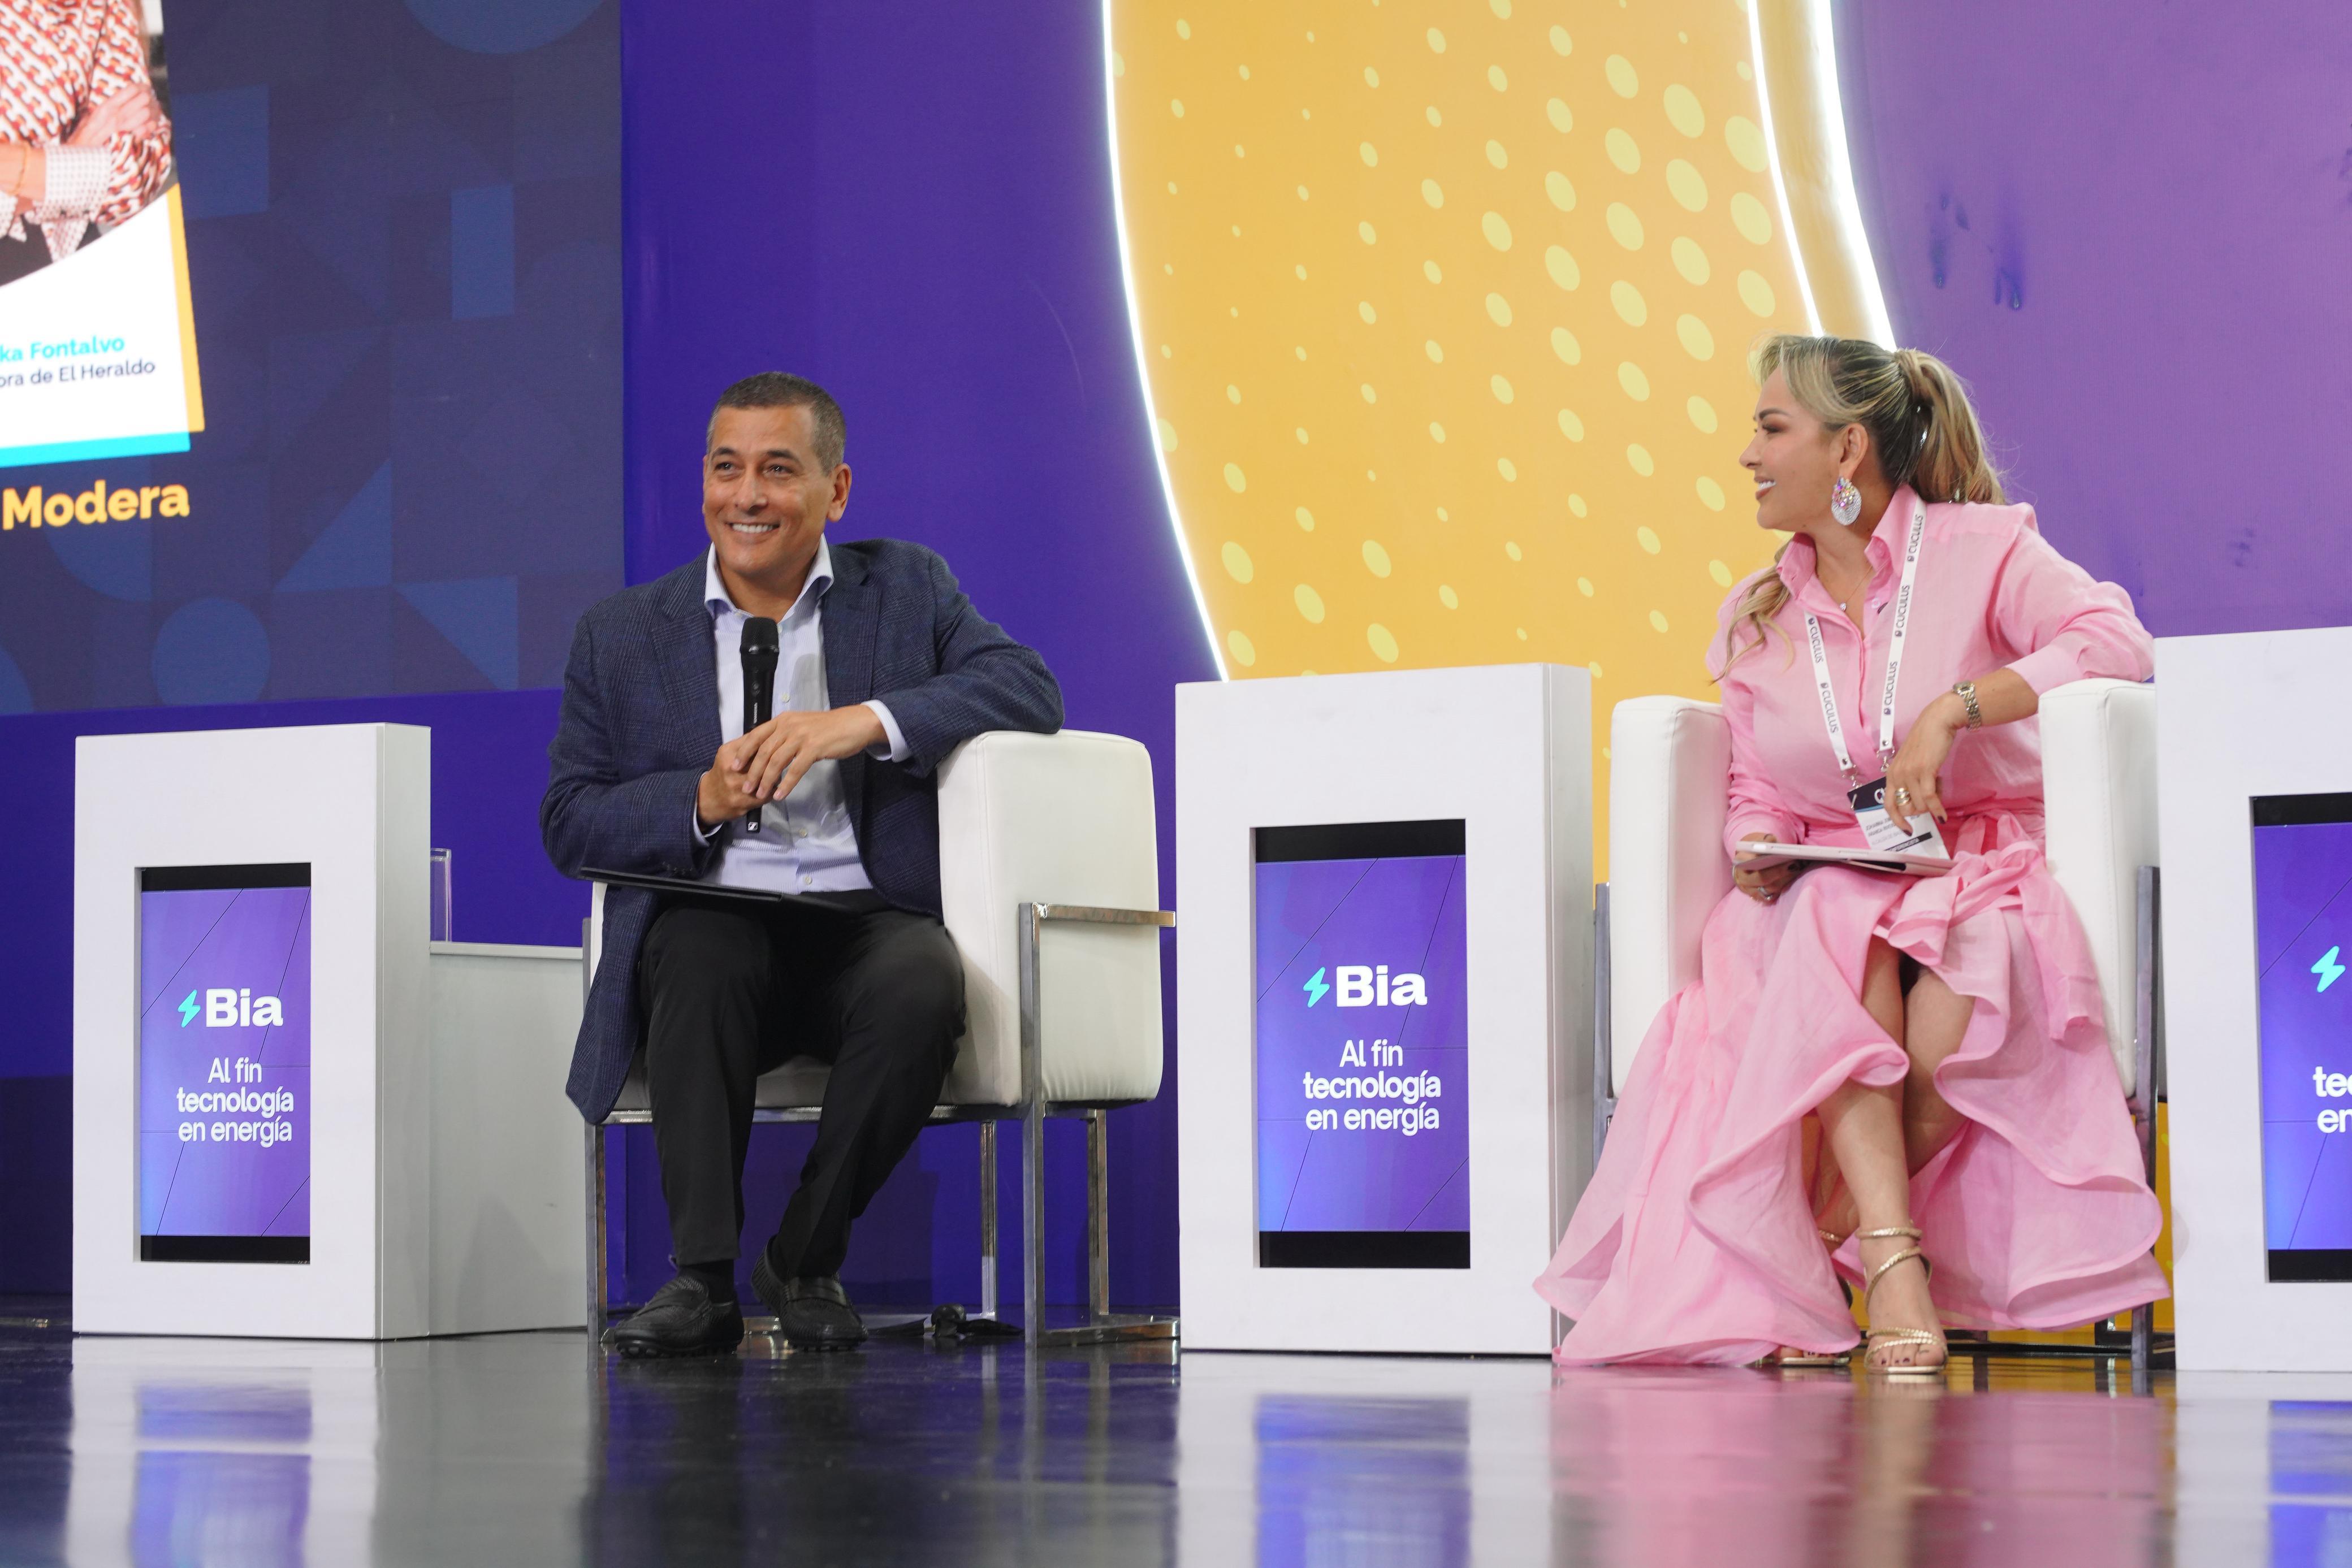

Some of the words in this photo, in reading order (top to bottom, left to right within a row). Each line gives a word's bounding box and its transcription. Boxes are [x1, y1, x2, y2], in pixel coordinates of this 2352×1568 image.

[30, 335, 125, 359] Fontalvo
[31, 367, 53, 384] de
[59, 365, 76, 382] El
[81, 358, 155, 379] Heraldo
[2, 479, 190, 530] Modera
[1908, 515, 1923, 554] CUCULUS
[1896, 584, 1910, 629] CUCULUS
[1810, 626, 1823, 663] CUCULUS
[1884, 661, 1897, 705] CUCULUS
[1822, 690, 1839, 733] CUCULUS
[1336, 964, 1428, 1007] Bia
[206, 988, 284, 1027] Bia
[207, 1057, 231, 1084] Al
[235, 1056, 262, 1083] fin
[1339, 1039, 1367, 1068] Al
[1370, 1038, 1403, 1067] fin
[1303, 1069, 1441, 1104] tecnología
[2312, 1066, 2352, 1097] te
[176, 1085, 294, 1119] tecnología
[1305, 1108, 1338, 1130] en
[1343, 1101, 1440, 1137] energía
[178, 1120, 206, 1142] en
[210, 1115, 292, 1148] energía
